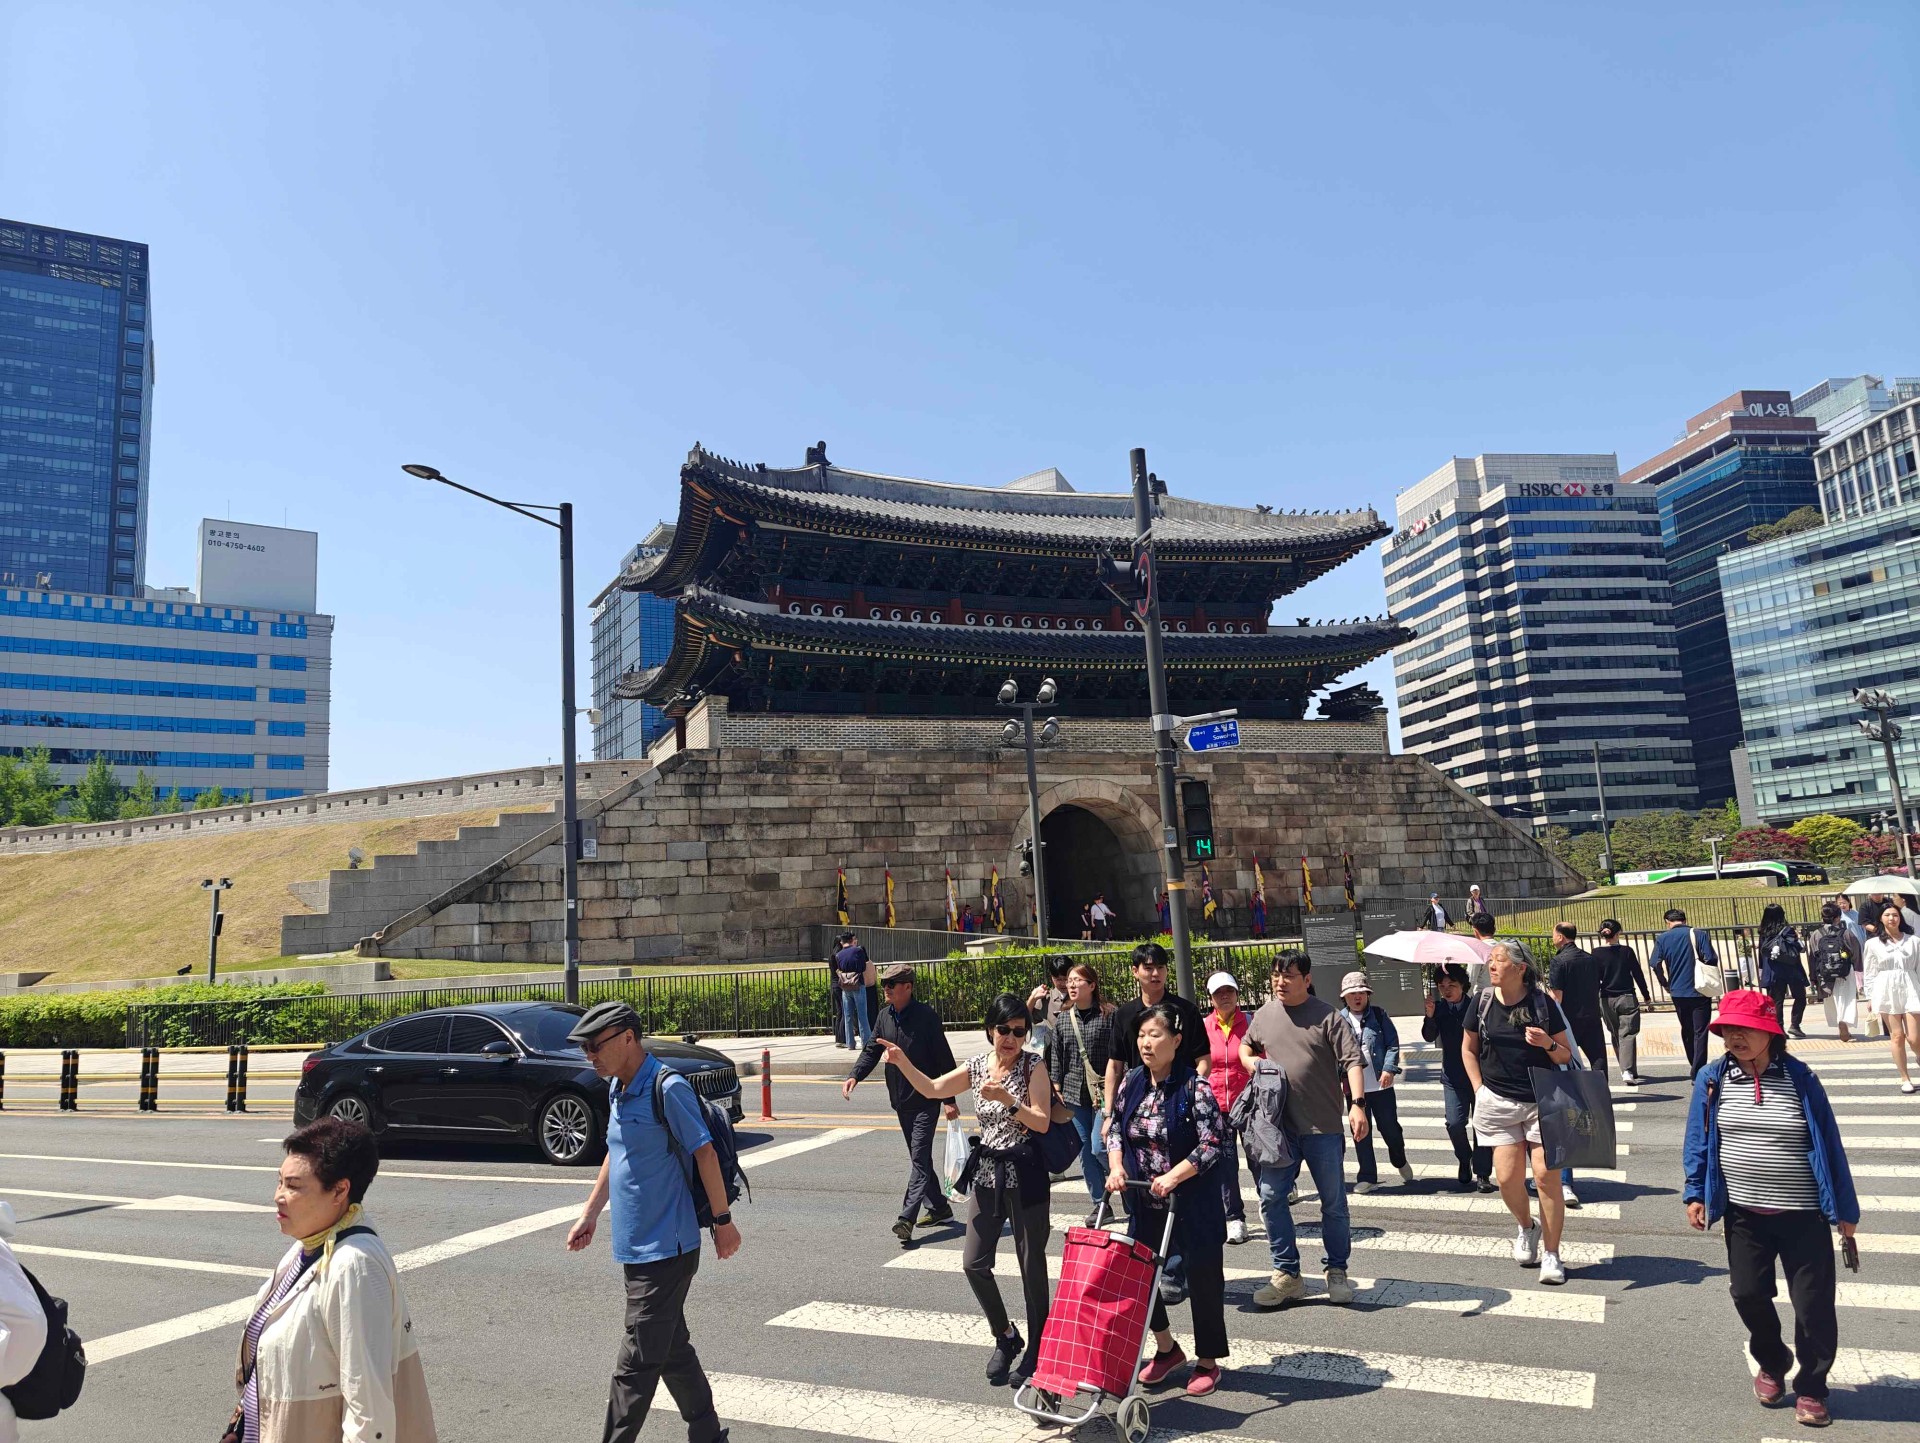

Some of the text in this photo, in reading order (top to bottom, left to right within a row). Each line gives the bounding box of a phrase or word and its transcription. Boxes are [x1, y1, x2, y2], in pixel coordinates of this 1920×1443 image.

[1519, 483, 1614, 497] HSBC 은행
[208, 540, 265, 552] 010-4750-4602
[1196, 838, 1212, 856] 14
